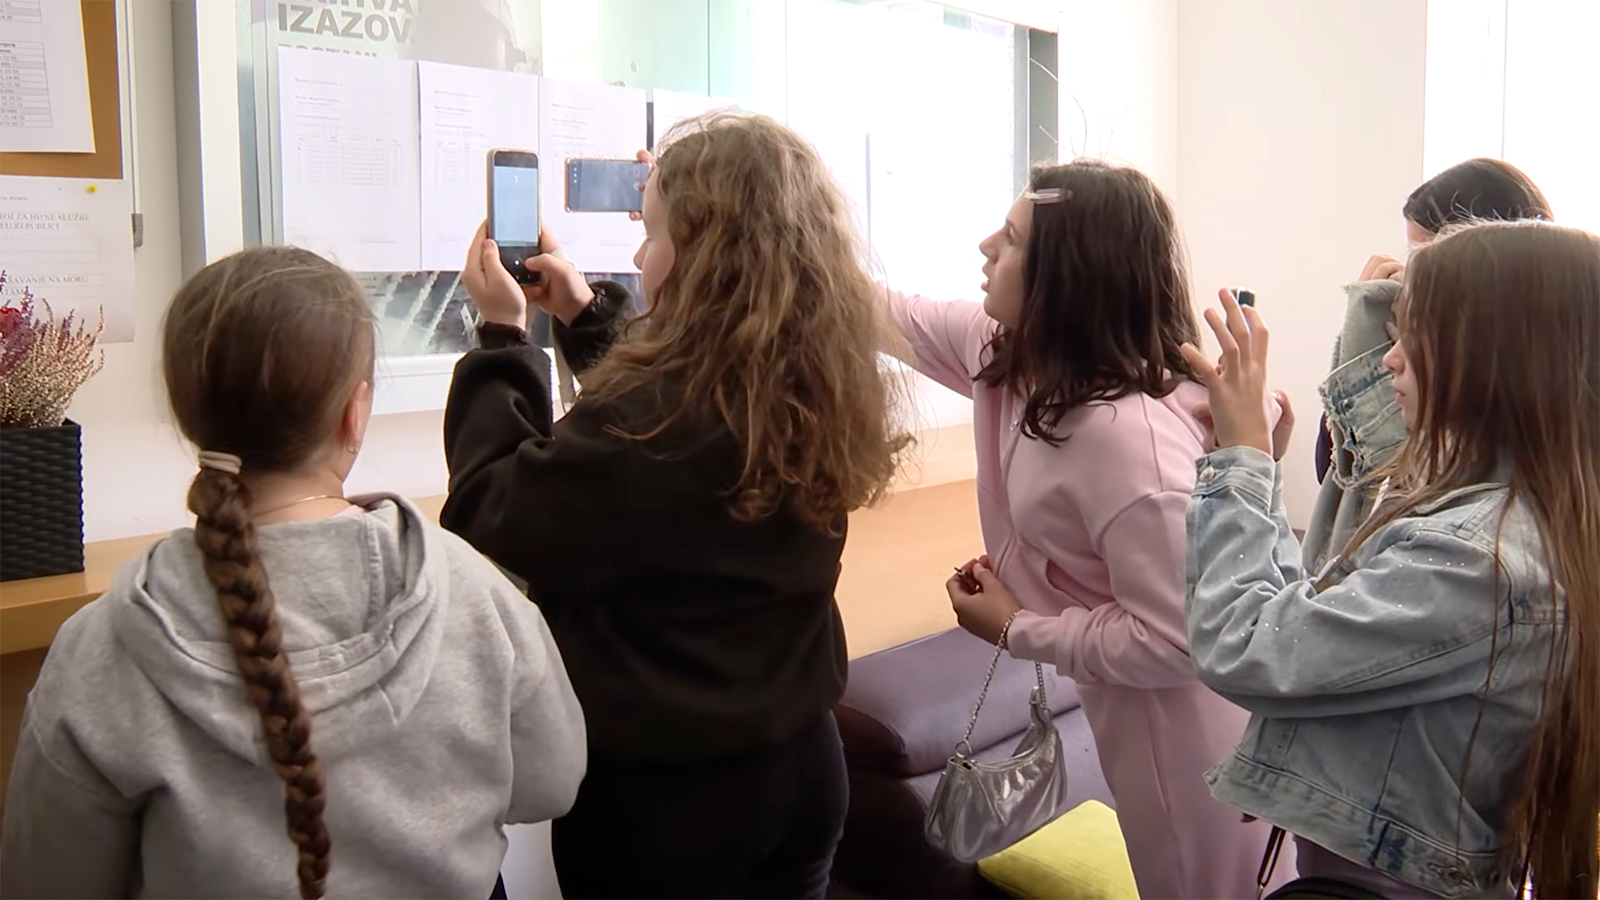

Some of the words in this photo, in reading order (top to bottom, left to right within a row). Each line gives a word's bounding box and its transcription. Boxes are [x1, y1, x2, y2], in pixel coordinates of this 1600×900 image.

[278, 3, 412, 44] IZAZOV
[48, 276, 61, 284] NA
[62, 275, 88, 284] MORU
